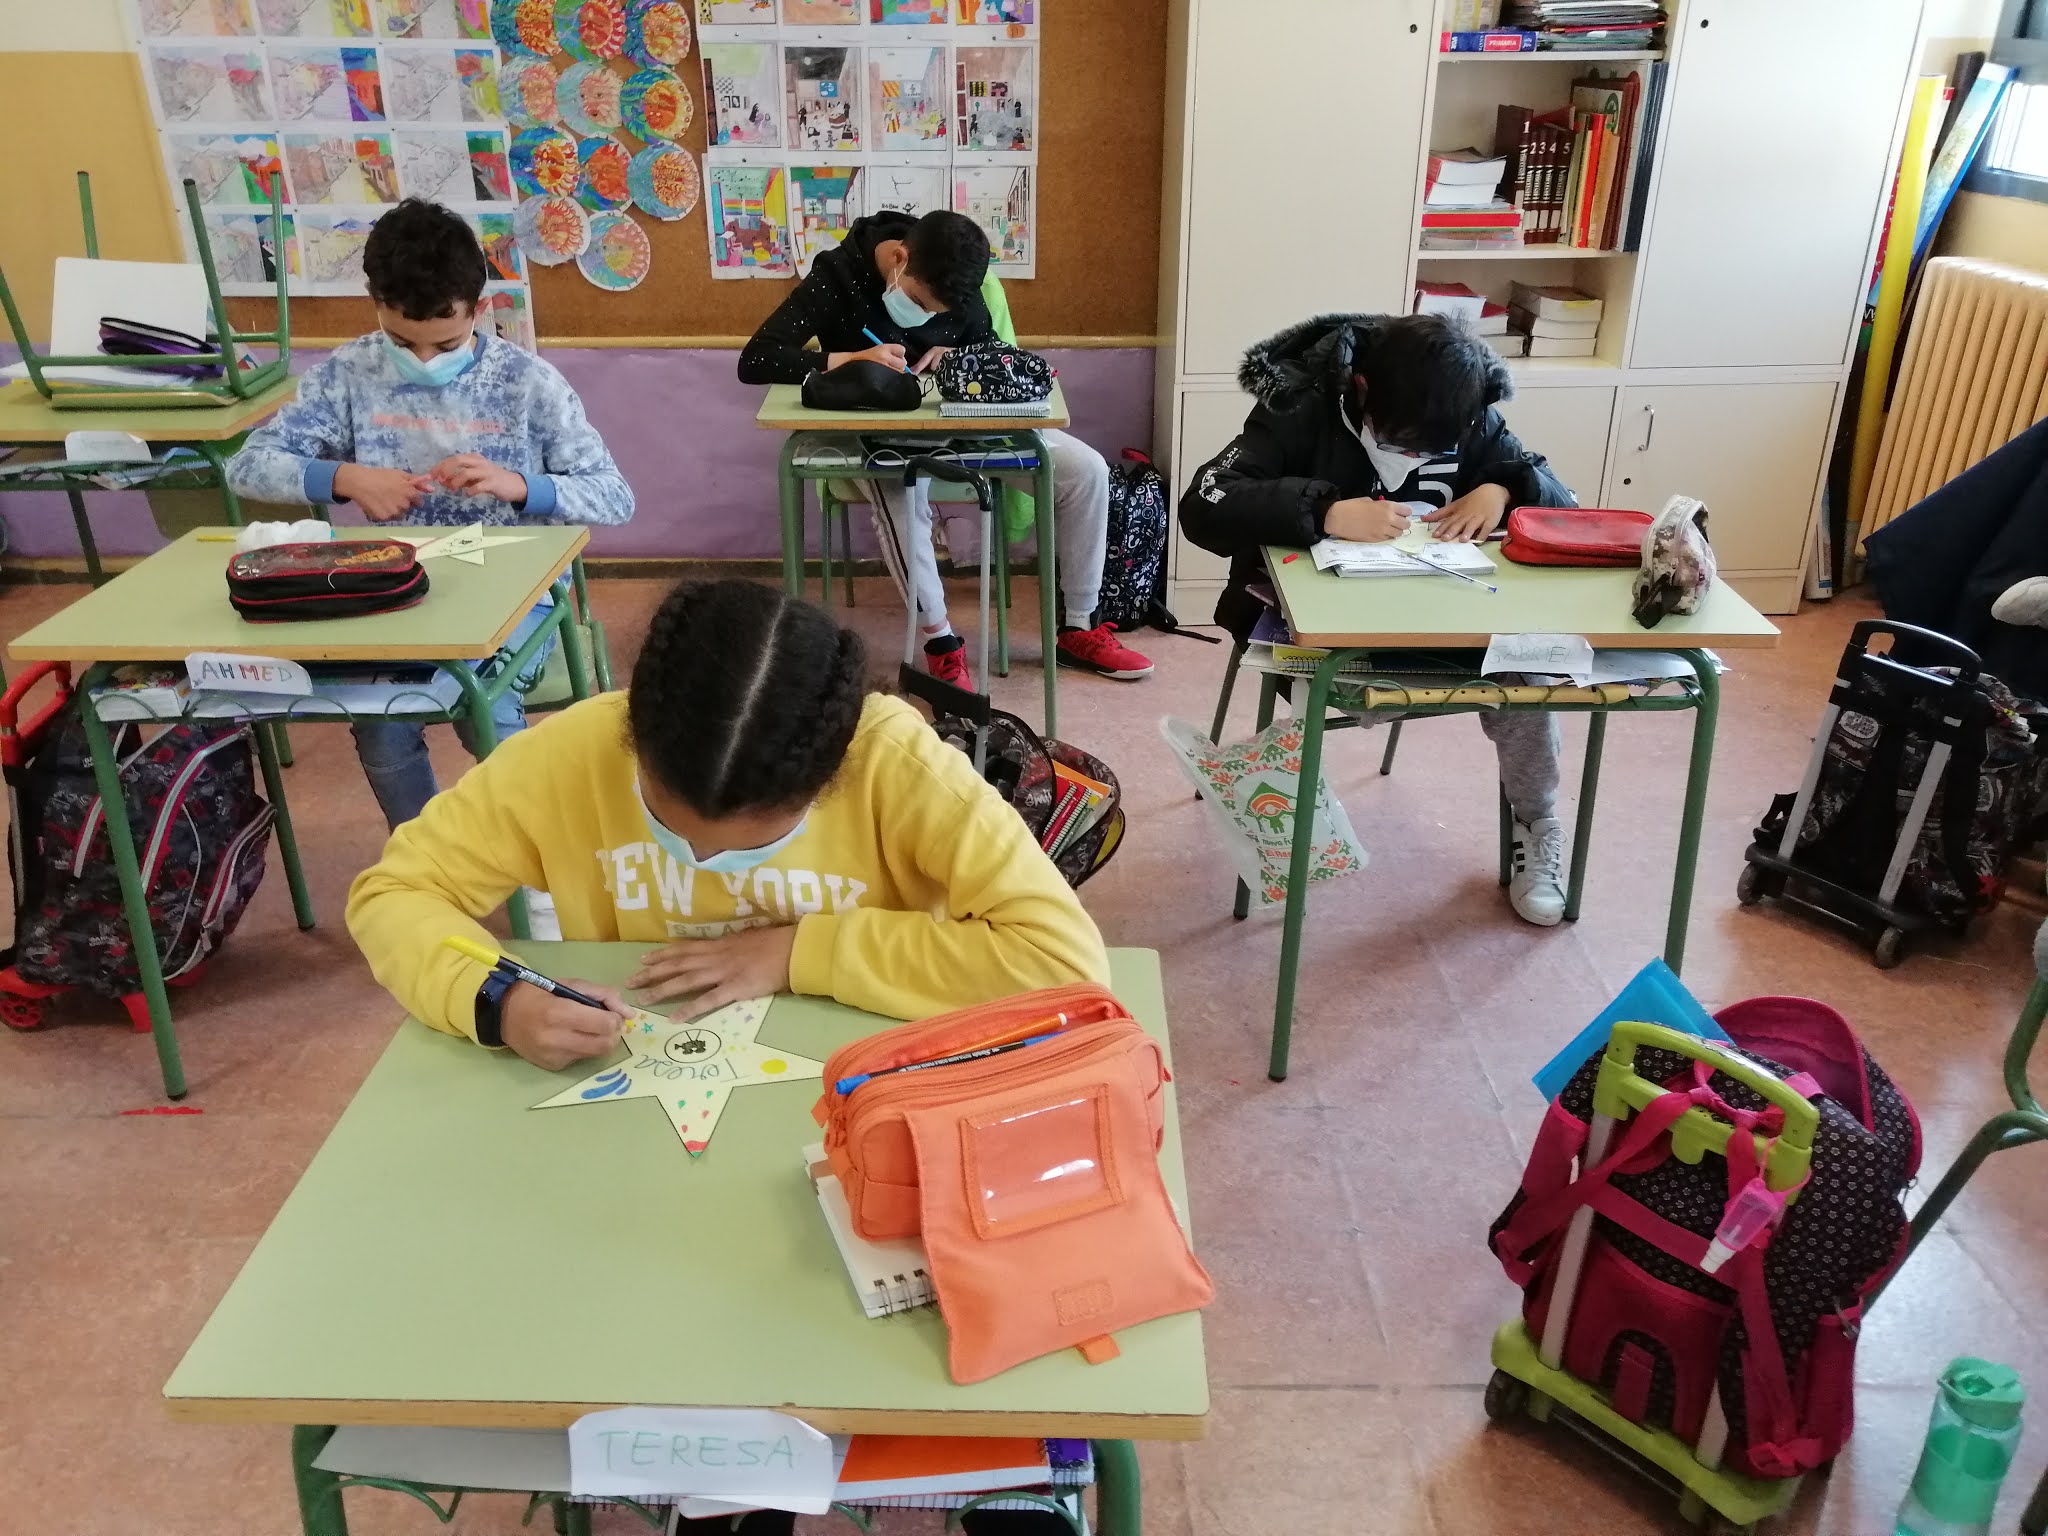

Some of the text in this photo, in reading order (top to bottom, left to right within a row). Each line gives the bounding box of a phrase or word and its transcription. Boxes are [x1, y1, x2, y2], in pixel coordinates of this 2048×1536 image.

[1523, 121, 1530, 133] 1
[1529, 142, 1537, 155] 2
[1538, 142, 1547, 155] 3
[1548, 142, 1557, 154] 4
[1562, 142, 1571, 155] 5
[1487, 644, 1577, 664] GABRIEL
[202, 660, 292, 681] AHMED
[634, 1055, 752, 1083] Teresa
[597, 1430, 794, 1470] TERESA
